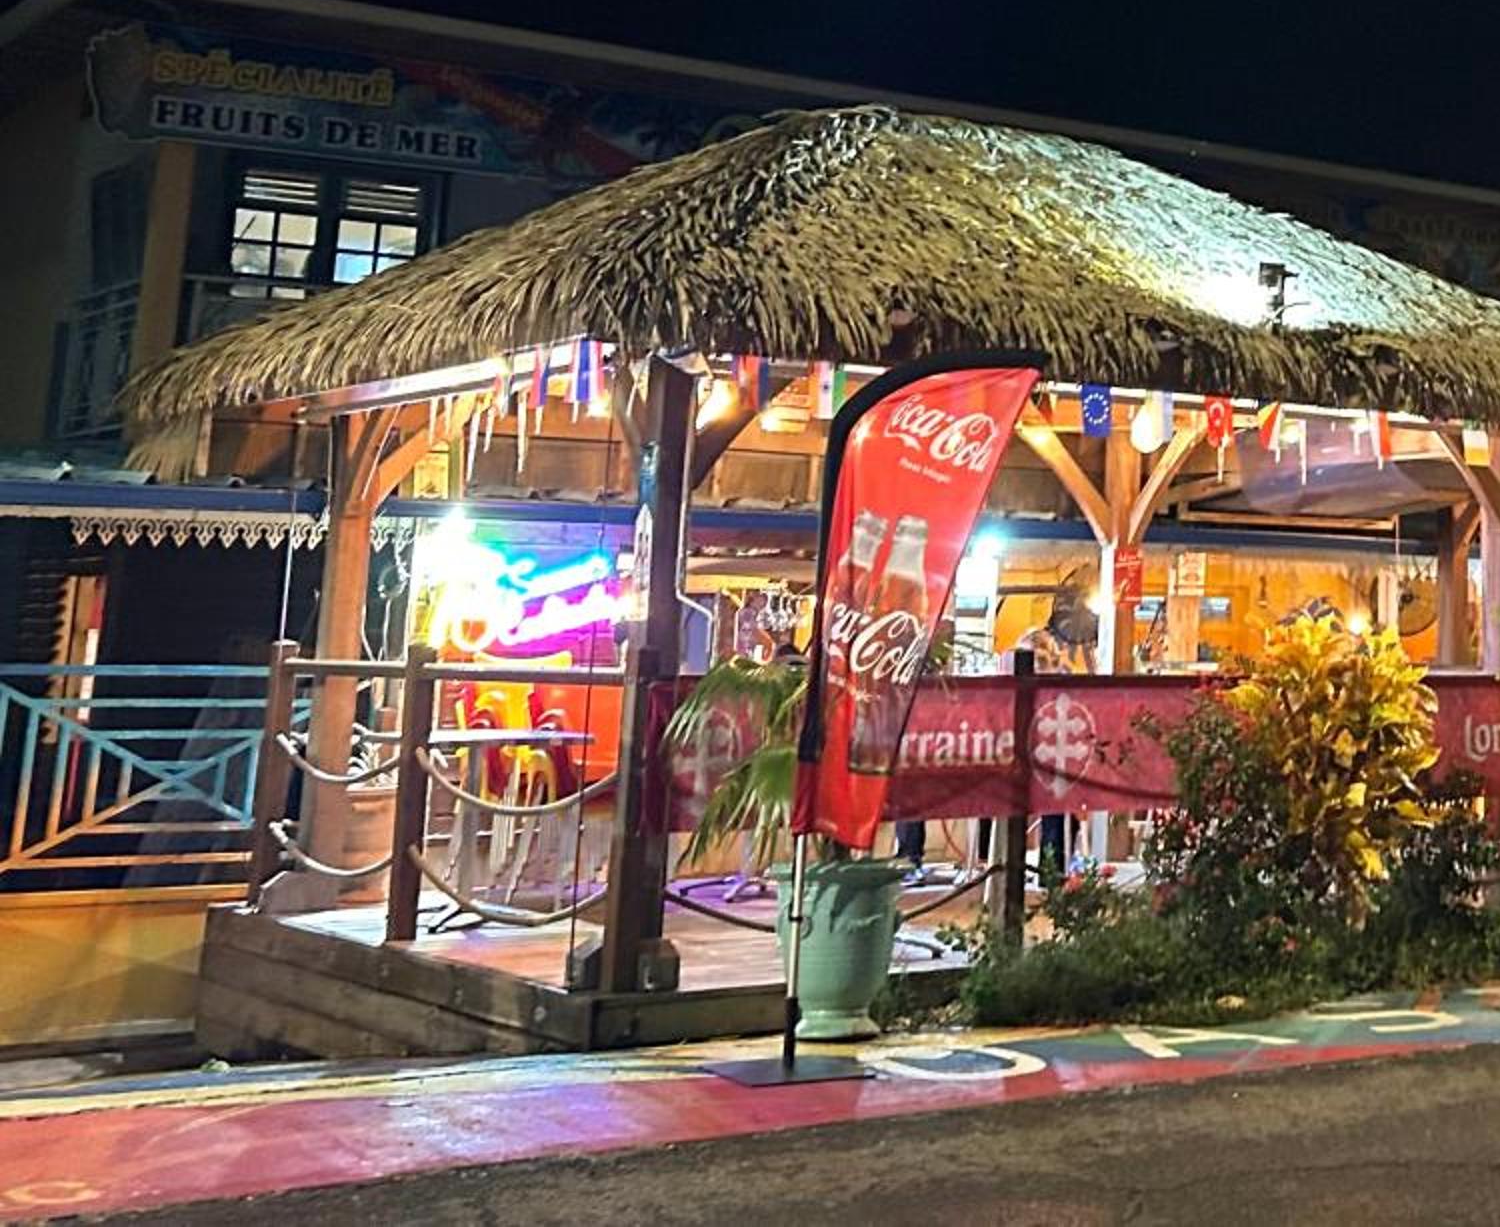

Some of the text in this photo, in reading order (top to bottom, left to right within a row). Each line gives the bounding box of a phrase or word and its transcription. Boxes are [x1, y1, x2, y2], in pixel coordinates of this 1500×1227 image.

[154, 98, 480, 160] FRUITS DE MER
[899, 720, 1015, 768] rraine
